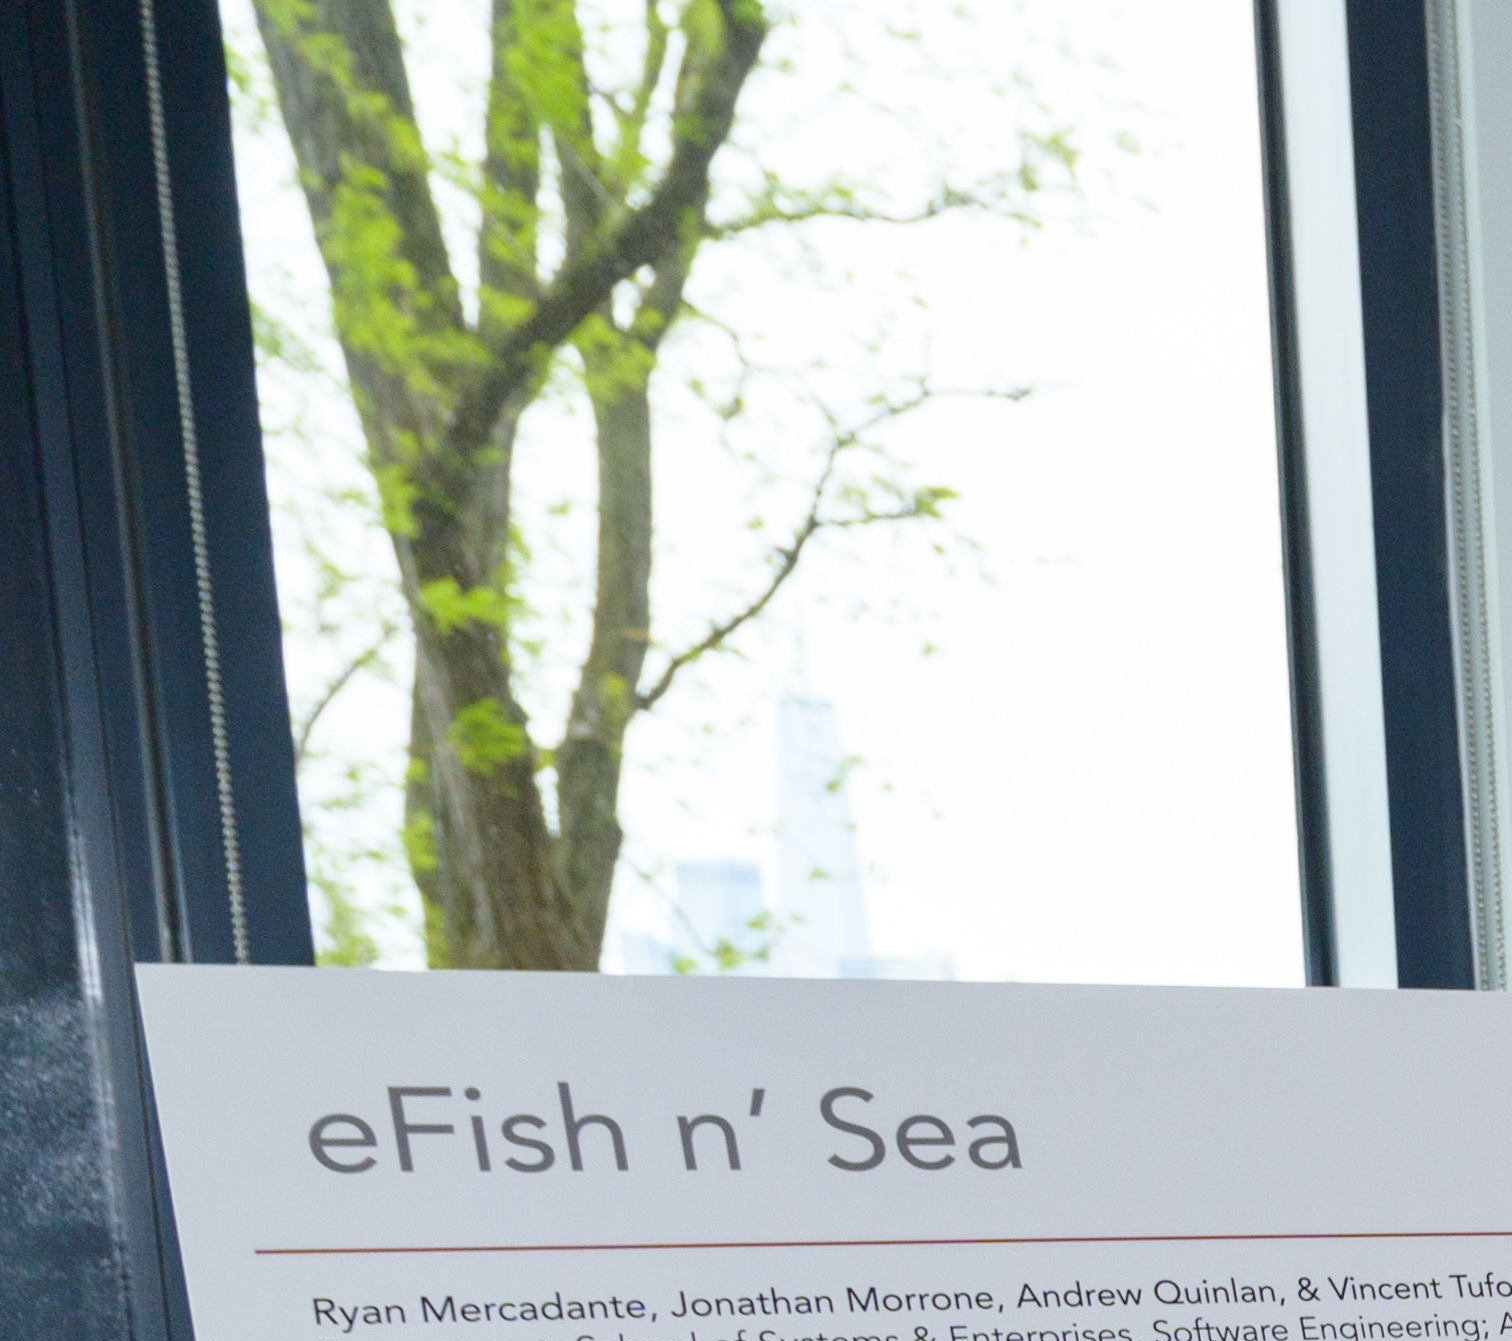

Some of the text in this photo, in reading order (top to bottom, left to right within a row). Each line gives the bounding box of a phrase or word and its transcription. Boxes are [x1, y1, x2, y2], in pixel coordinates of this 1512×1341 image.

[308, 1081, 629, 1175] eFish
[819, 1086, 1023, 1172] Sea
[312, 1298, 407, 1334] Ryan
[420, 1291, 657, 1323] Mercadante,
[670, 1286, 834, 1318] Jonathan
[846, 1286, 1004, 1314] Morrone,
[1017, 1280, 1142, 1309] Andrew
[1153, 1277, 1285, 1307] Quinlan,
[1297, 1276, 1321, 1302] &
[1327, 1276, 1443, 1301] Vincent
